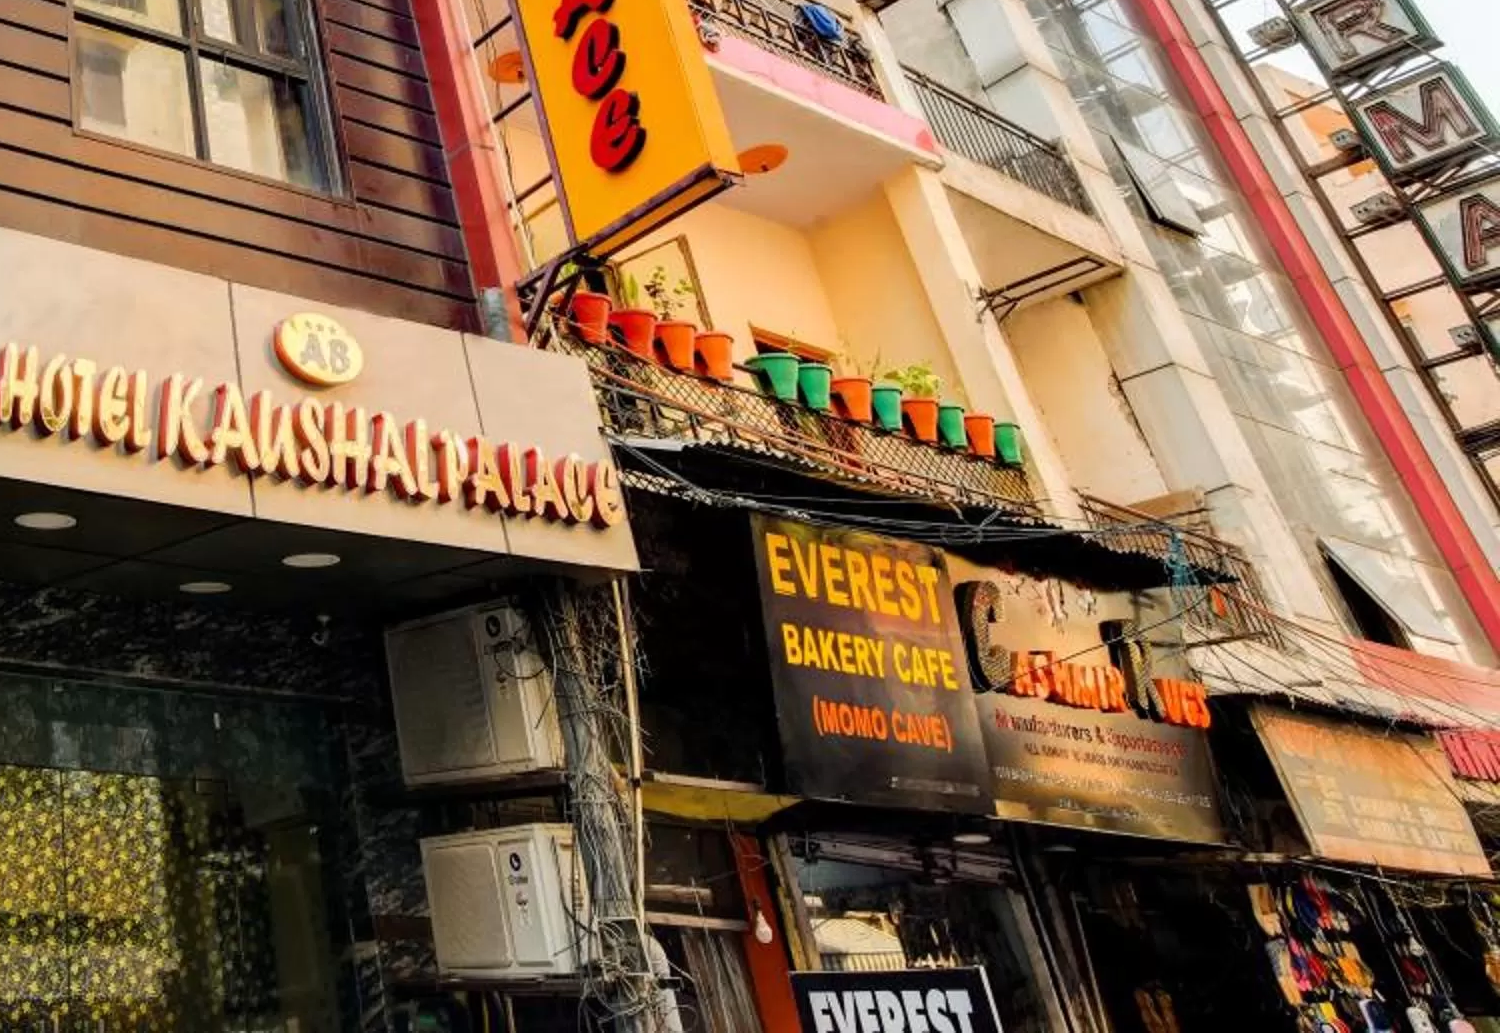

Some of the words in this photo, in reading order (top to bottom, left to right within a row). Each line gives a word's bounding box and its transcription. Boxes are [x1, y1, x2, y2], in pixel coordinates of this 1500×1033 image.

[158, 372, 431, 500] KAUSHAL
[434, 429, 624, 527] PALACE
[764, 532, 942, 624] EVEREST
[782, 624, 886, 680] BAKERY
[893, 643, 961, 691] CAFE
[813, 695, 888, 741] (MOMO
[808, 989, 974, 1033] EVEREST
